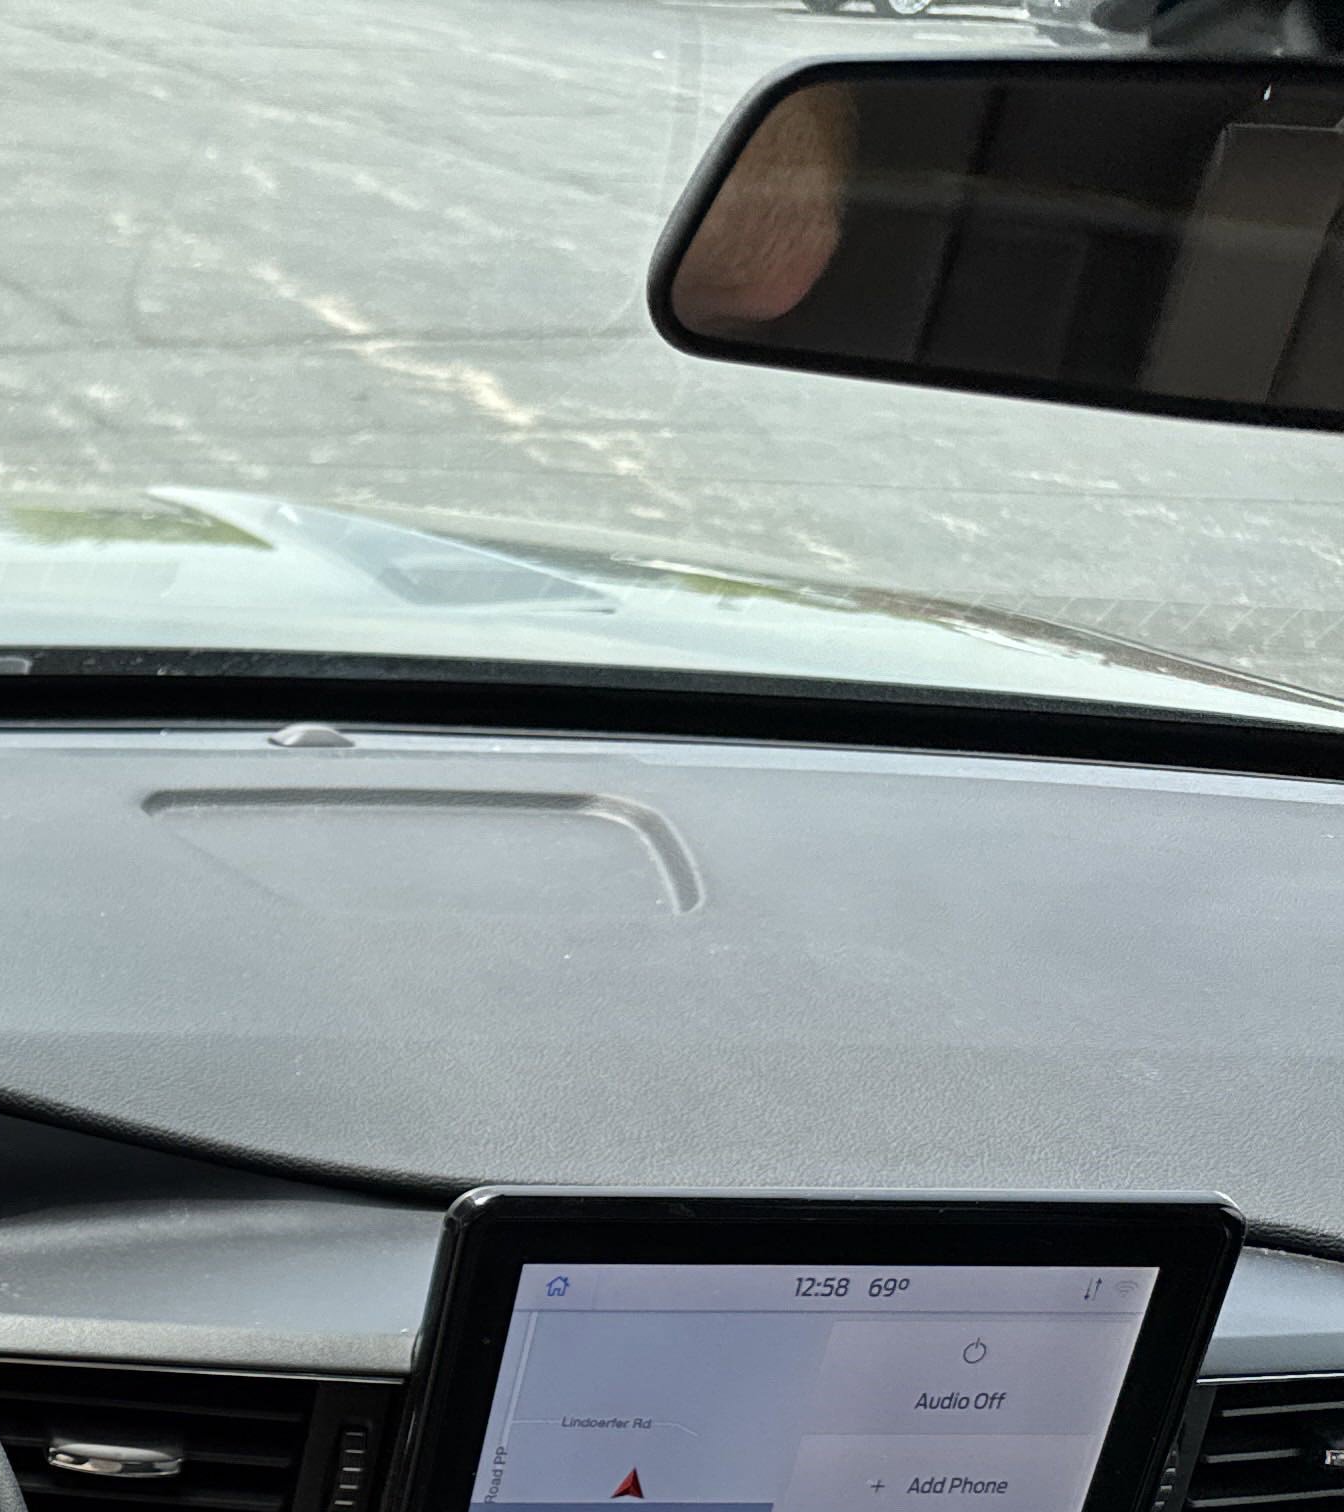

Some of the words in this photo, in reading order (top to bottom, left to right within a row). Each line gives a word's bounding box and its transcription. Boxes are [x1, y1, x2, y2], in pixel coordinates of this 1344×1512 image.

[793, 1276, 851, 1298] 12:58
[914, 1391, 970, 1411] Audio
[973, 1392, 1007, 1411] Off
[632, 1418, 652, 1430] Rd
[906, 1477, 946, 1495] Add
[948, 1477, 1009, 1495] Phone
